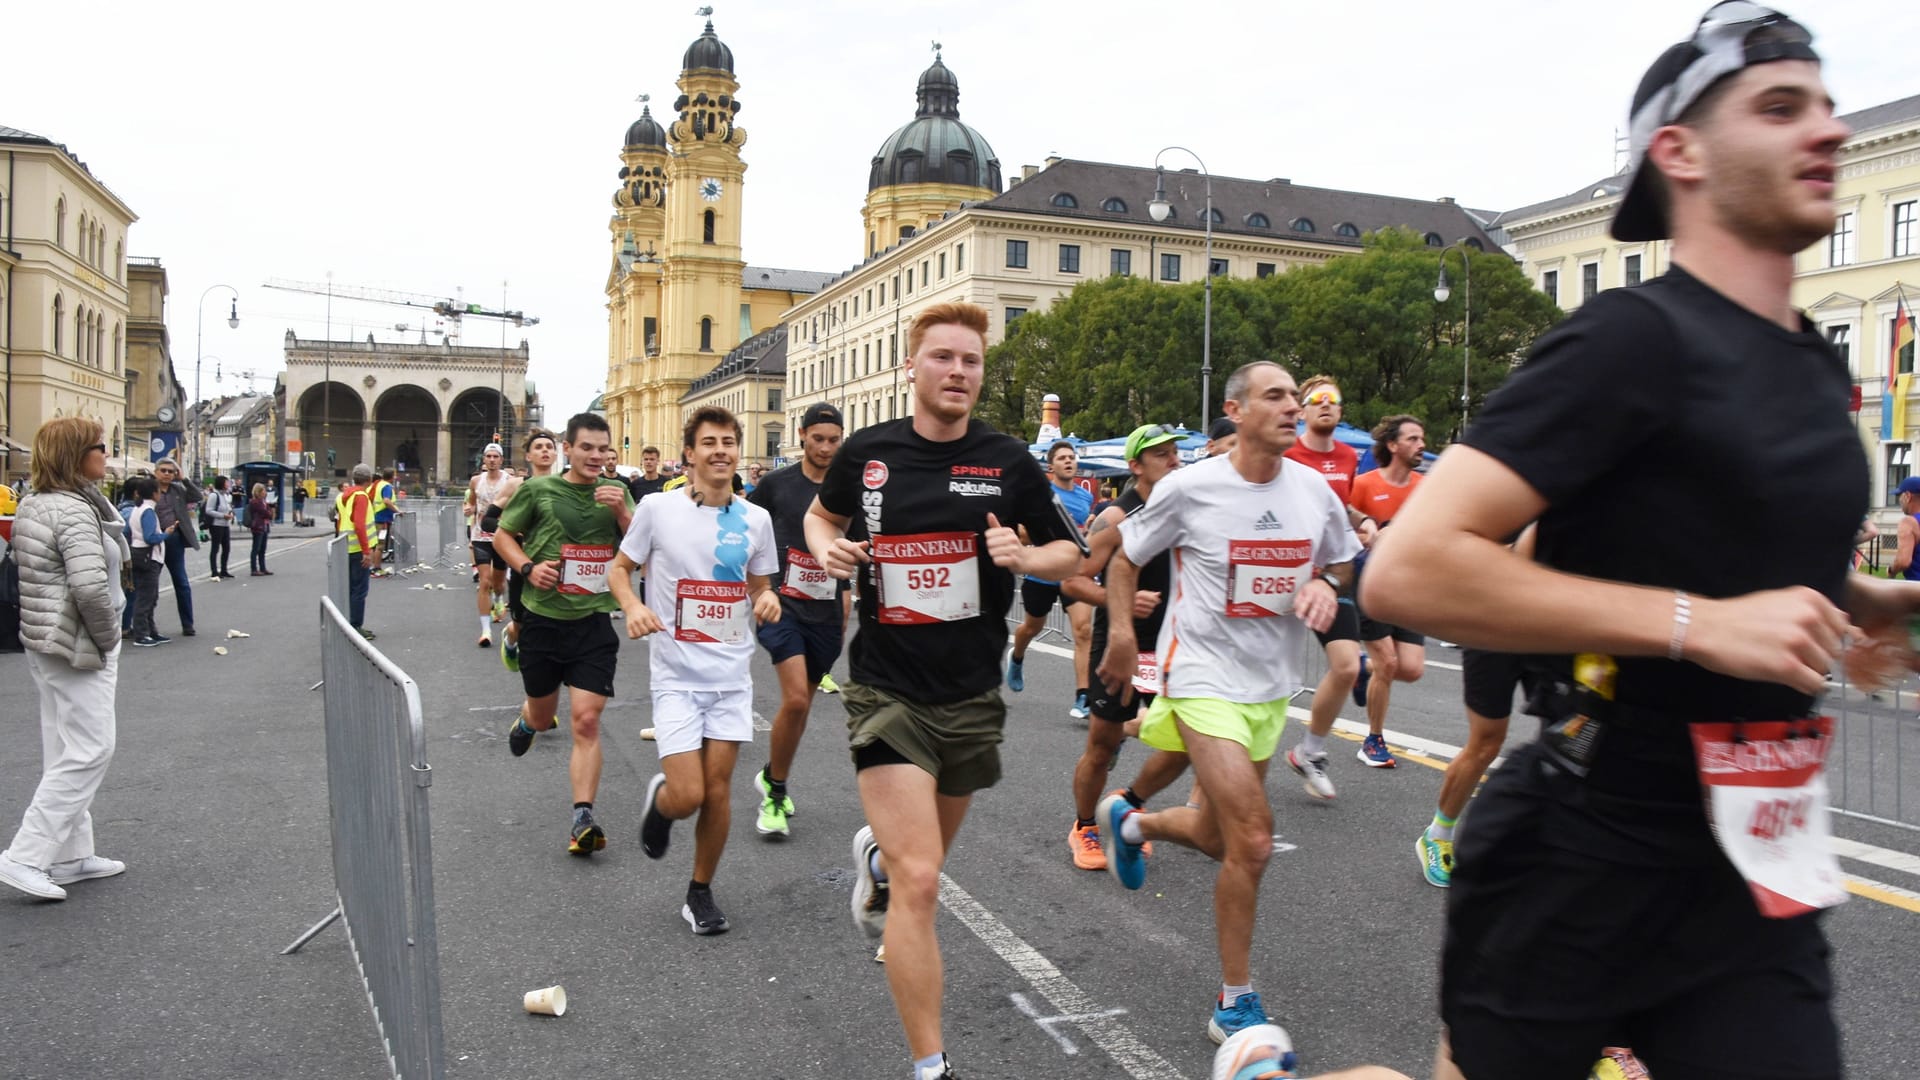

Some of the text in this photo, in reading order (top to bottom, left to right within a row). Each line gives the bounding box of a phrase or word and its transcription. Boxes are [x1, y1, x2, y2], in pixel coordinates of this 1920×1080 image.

[951, 465, 1002, 476] SPRINT
[949, 481, 1002, 496] Rakuten
[895, 540, 974, 557] GENERALI
[576, 564, 606, 576] 3840
[799, 570, 828, 582] 3656
[907, 567, 951, 590] 592
[1252, 577, 1296, 594] 6265
[696, 585, 746, 597] GENERALI
[697, 605, 732, 619] 3491
